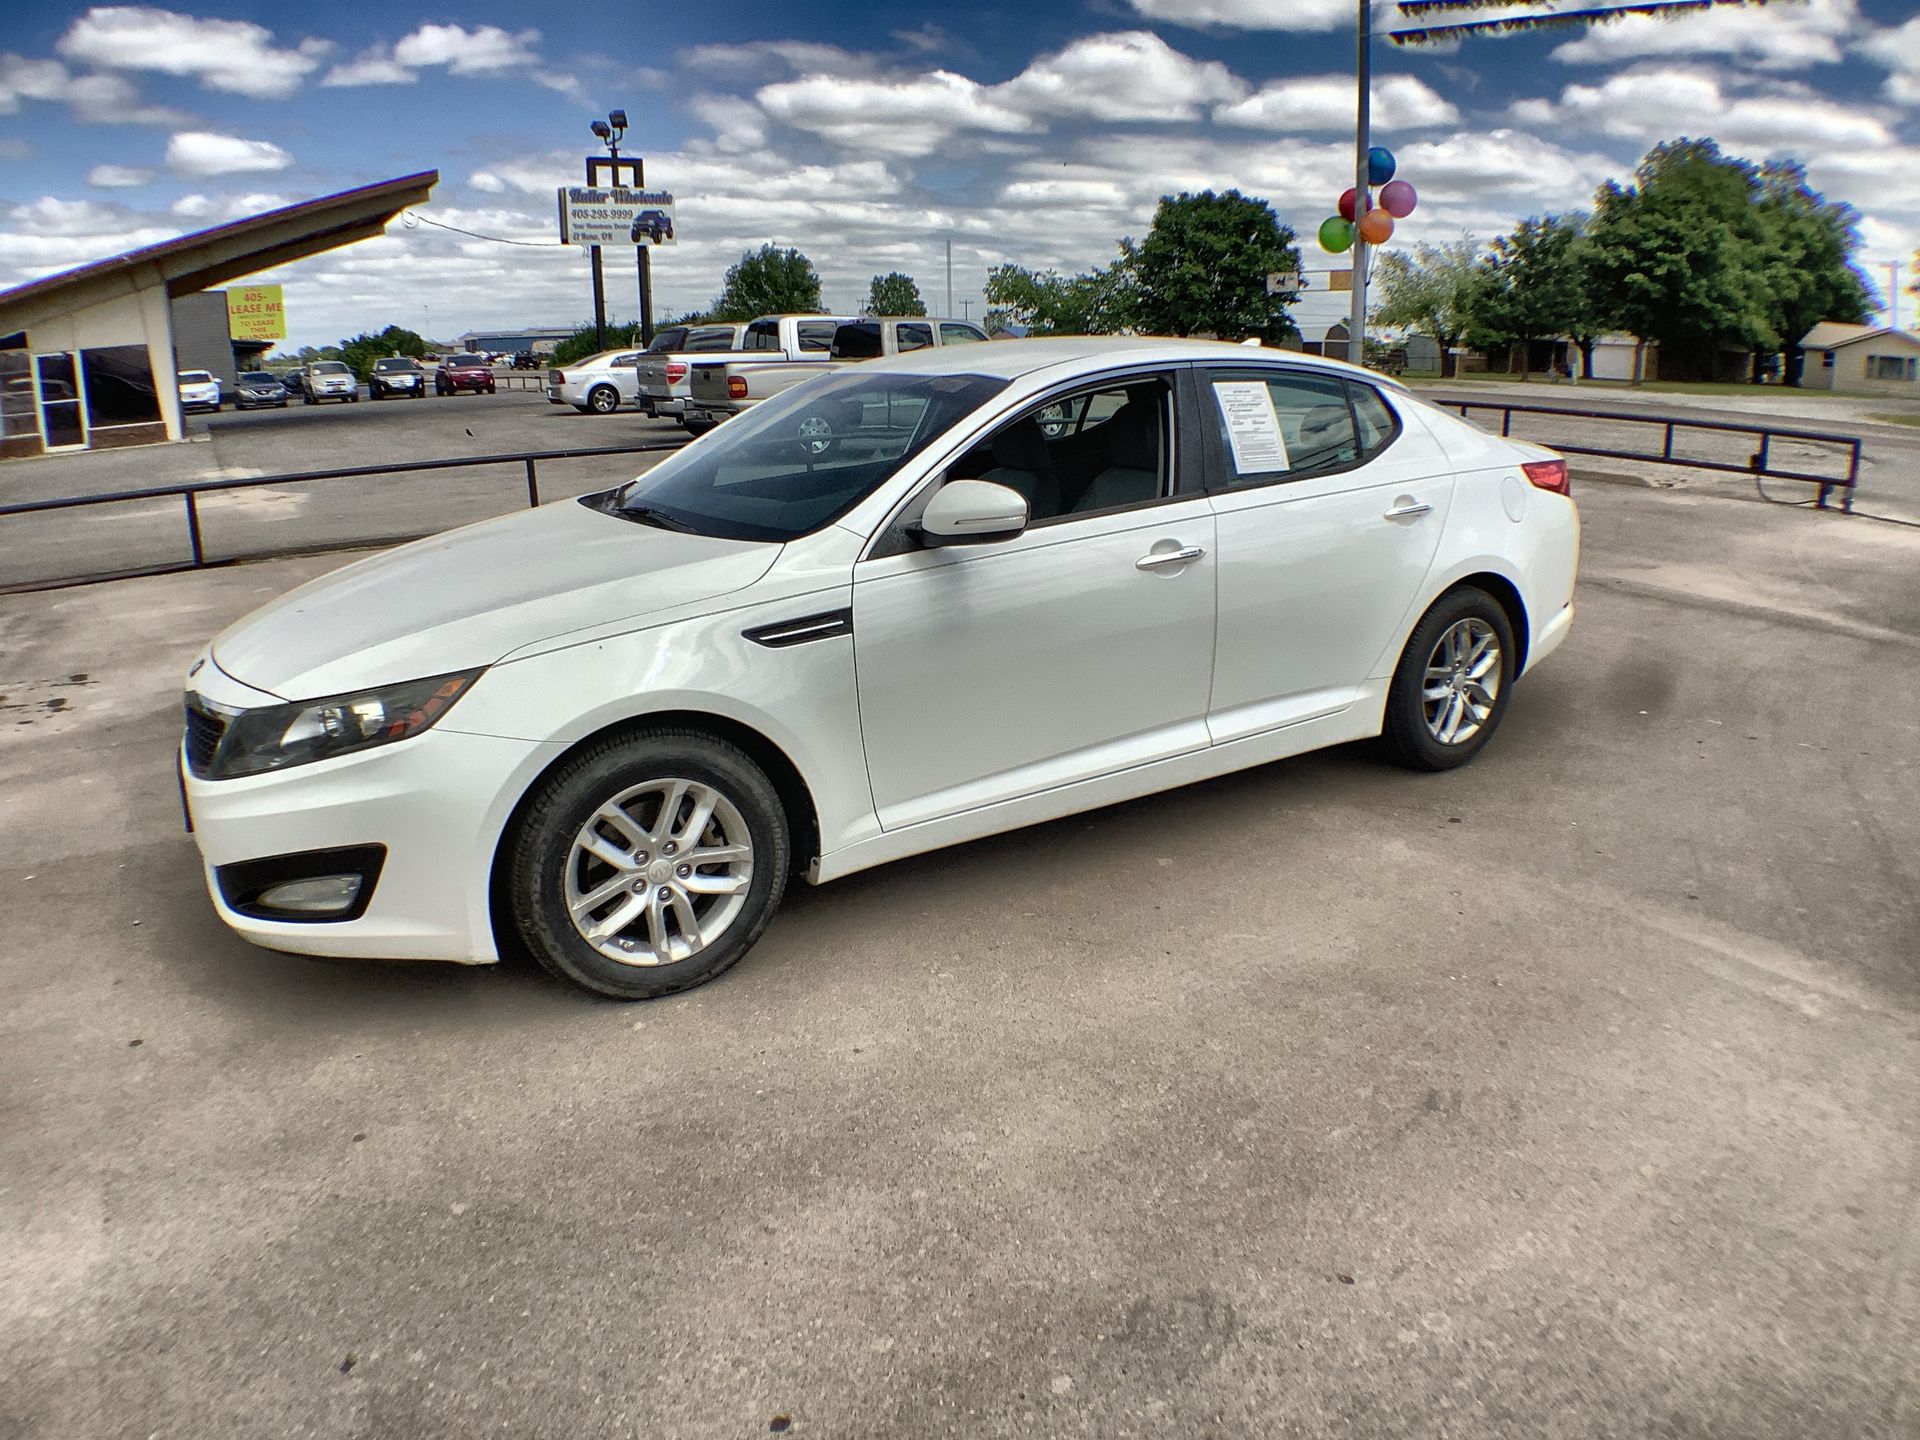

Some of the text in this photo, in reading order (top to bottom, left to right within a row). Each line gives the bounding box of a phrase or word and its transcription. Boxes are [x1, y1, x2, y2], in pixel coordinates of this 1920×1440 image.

[571, 208, 633, 219] 405-295-9999
[243, 292, 267, 302] 405-
[231, 303, 282, 314] LEASE ME
[252, 319, 275, 327] LEASE
